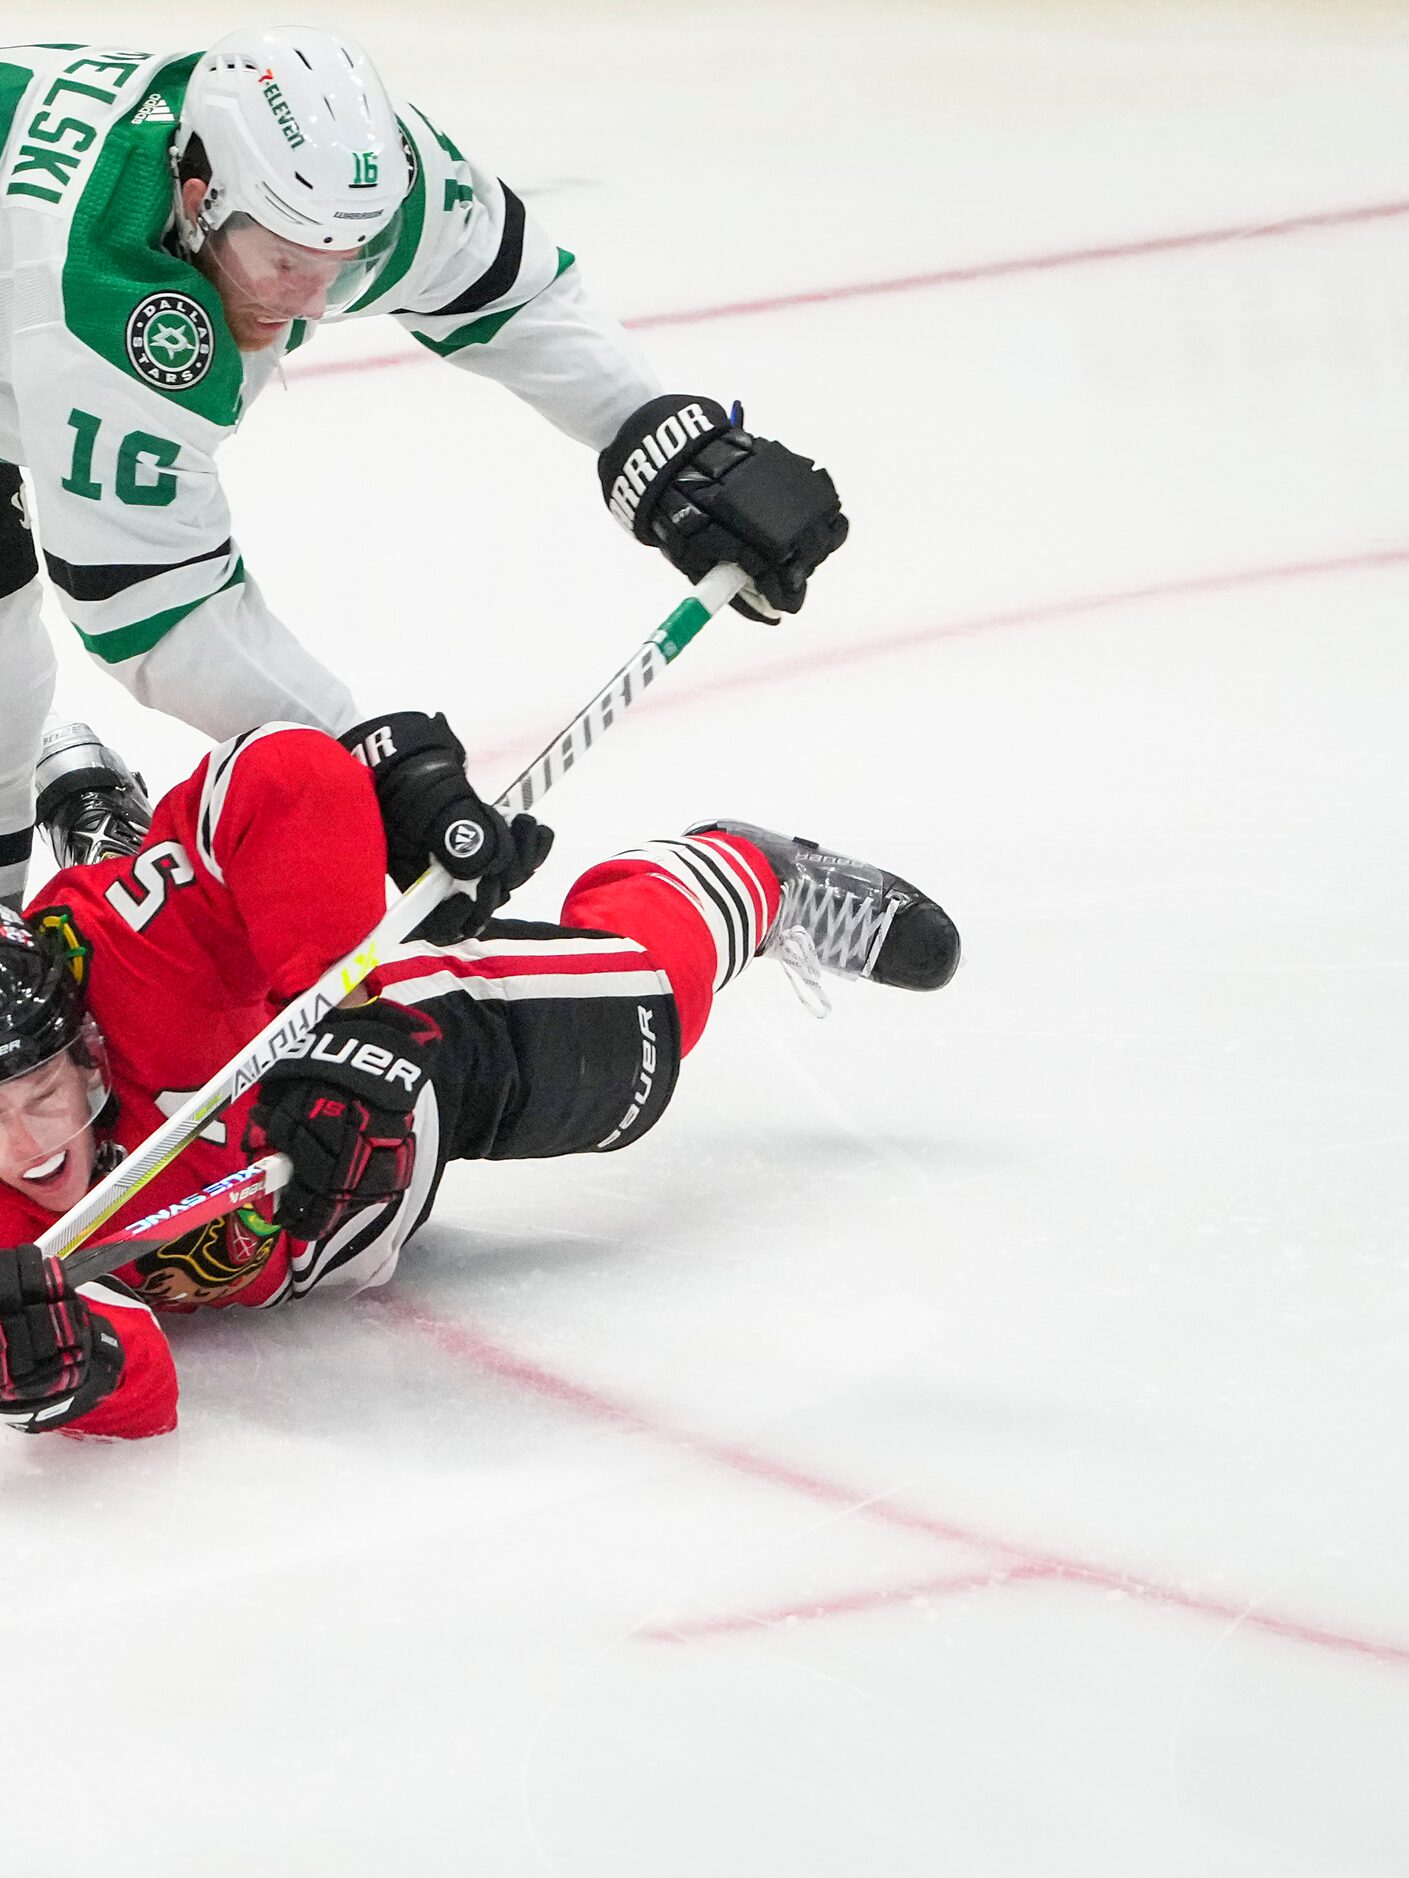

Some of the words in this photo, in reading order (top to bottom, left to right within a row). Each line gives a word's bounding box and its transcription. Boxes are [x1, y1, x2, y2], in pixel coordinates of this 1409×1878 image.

[130, 93, 162, 125] adidas
[351, 151, 379, 185] 16
[142, 299, 210, 355] DALLAS
[132, 336, 194, 383] STARS
[103, 839, 196, 934] 5
[230, 992, 334, 1101] ALPHA
